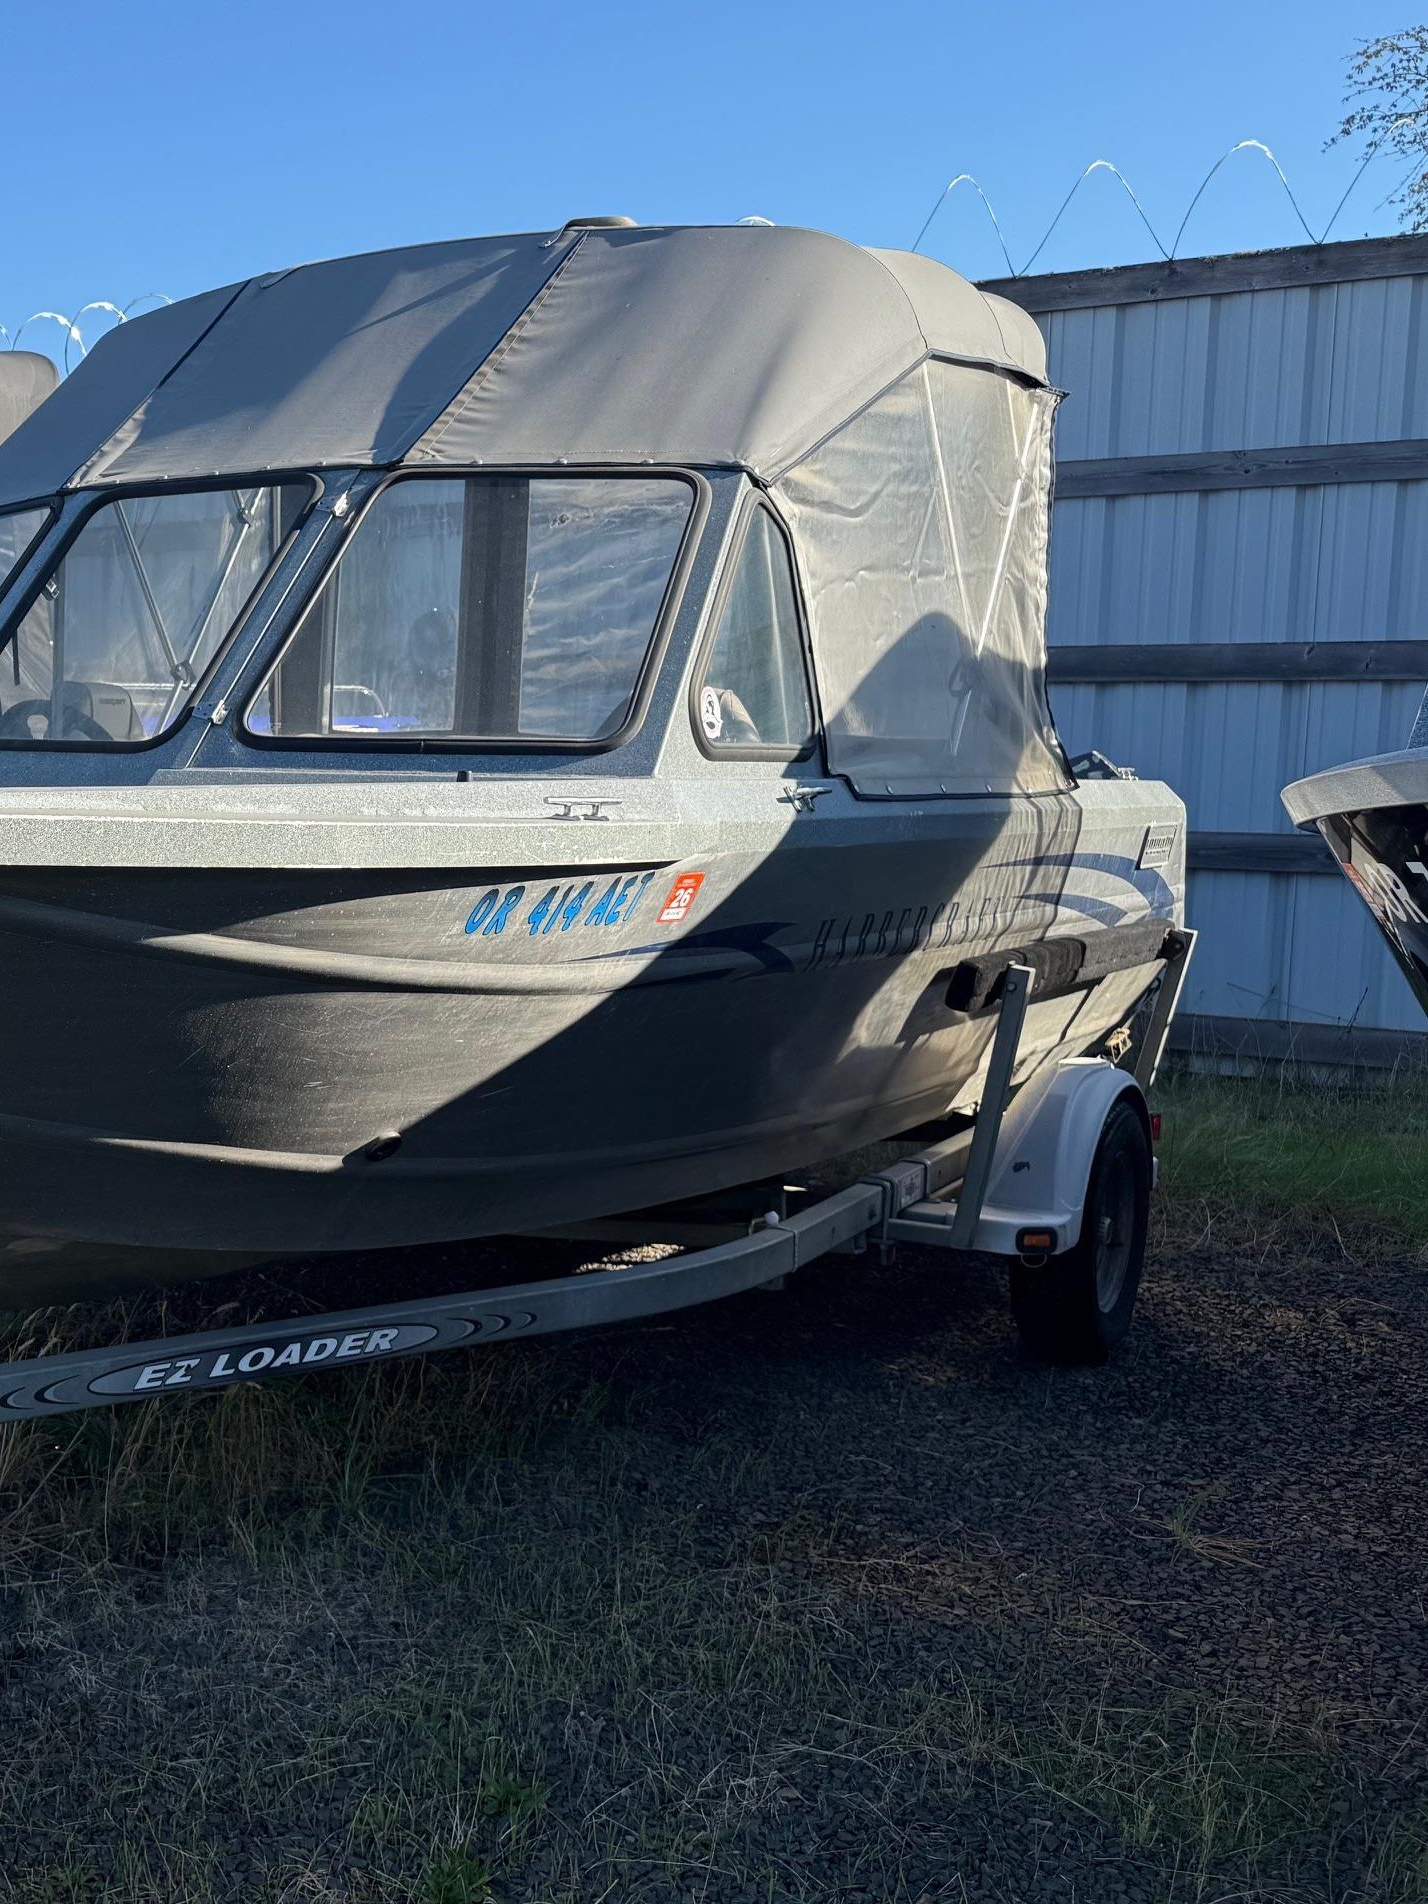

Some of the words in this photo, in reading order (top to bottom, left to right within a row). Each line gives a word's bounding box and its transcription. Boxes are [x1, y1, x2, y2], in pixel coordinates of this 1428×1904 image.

[465, 886, 525, 935] OR
[528, 881, 594, 935] 414
[585, 871, 655, 926] AET
[670, 888, 694, 907] 26
[133, 1358, 201, 1391] EZ
[209, 1328, 399, 1378] LOADER
